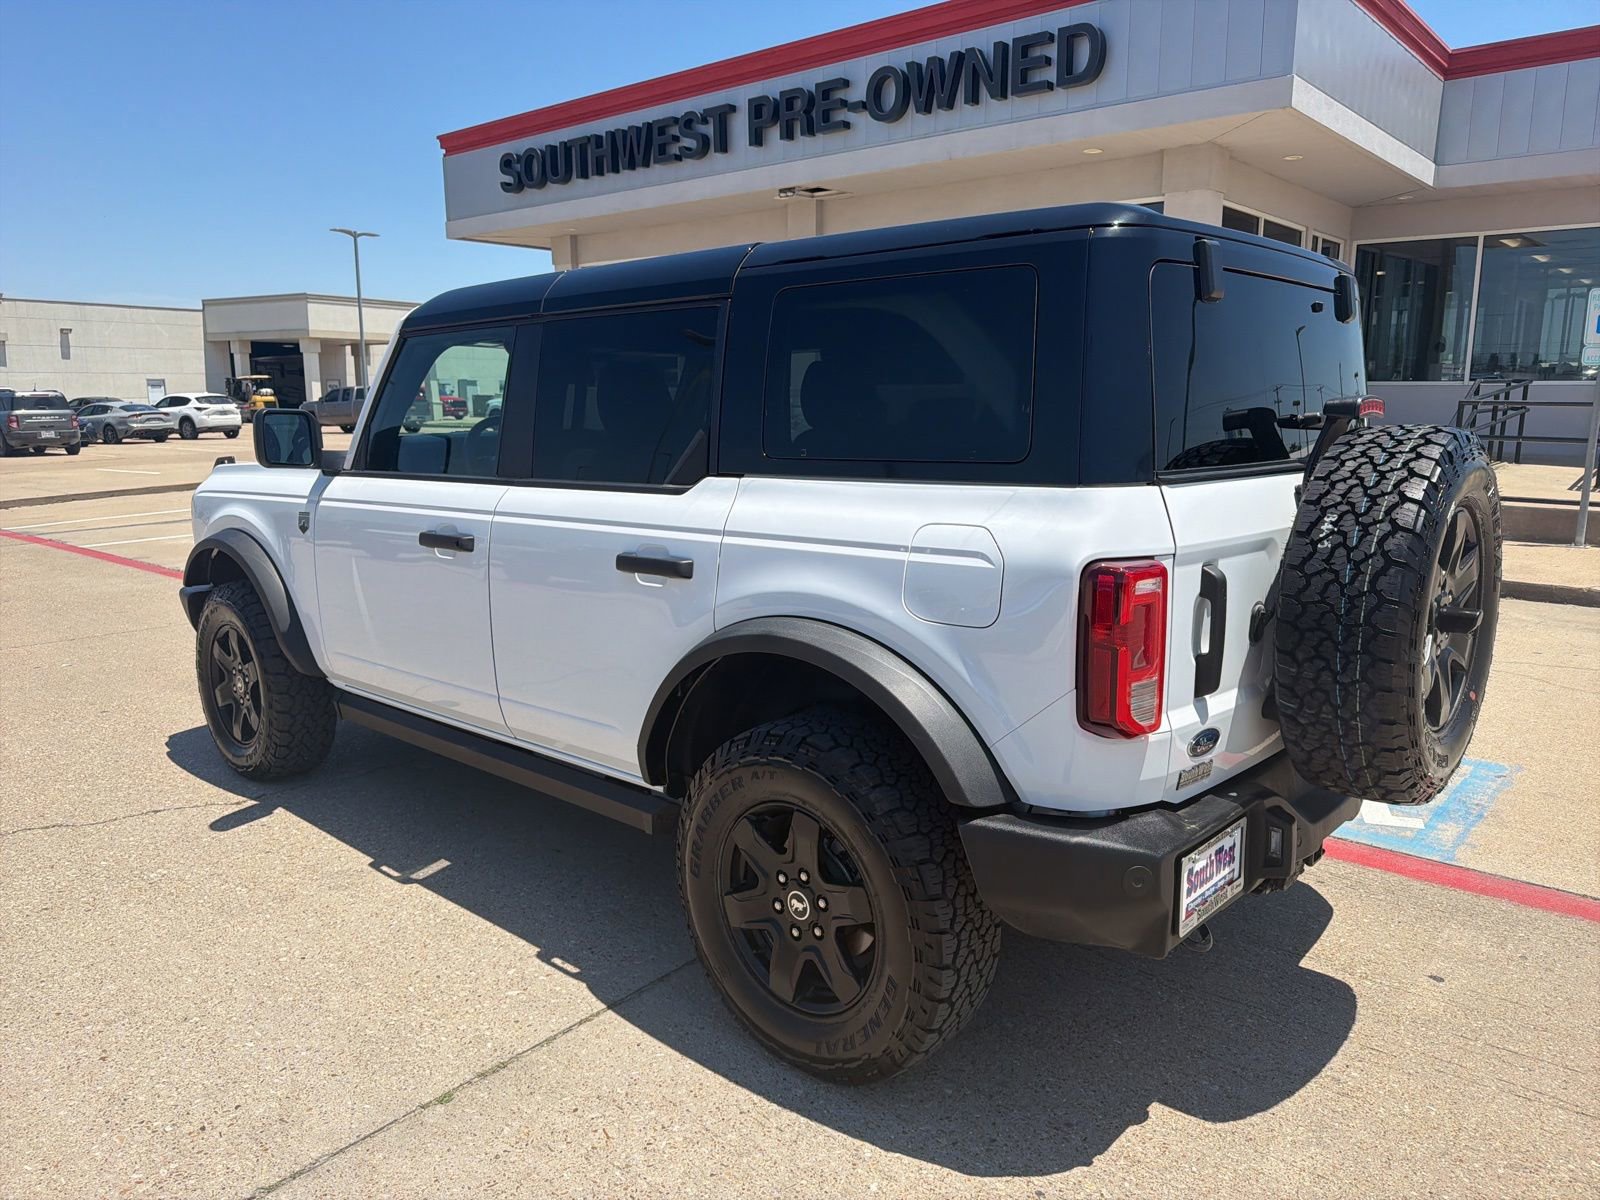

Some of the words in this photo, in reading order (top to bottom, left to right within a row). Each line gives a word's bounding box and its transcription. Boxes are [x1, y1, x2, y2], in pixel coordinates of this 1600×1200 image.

[499, 103, 737, 195] SOUTHWEST
[747, 21, 1108, 147] PRE-OWNED
[751, 769, 778, 782] A/T
